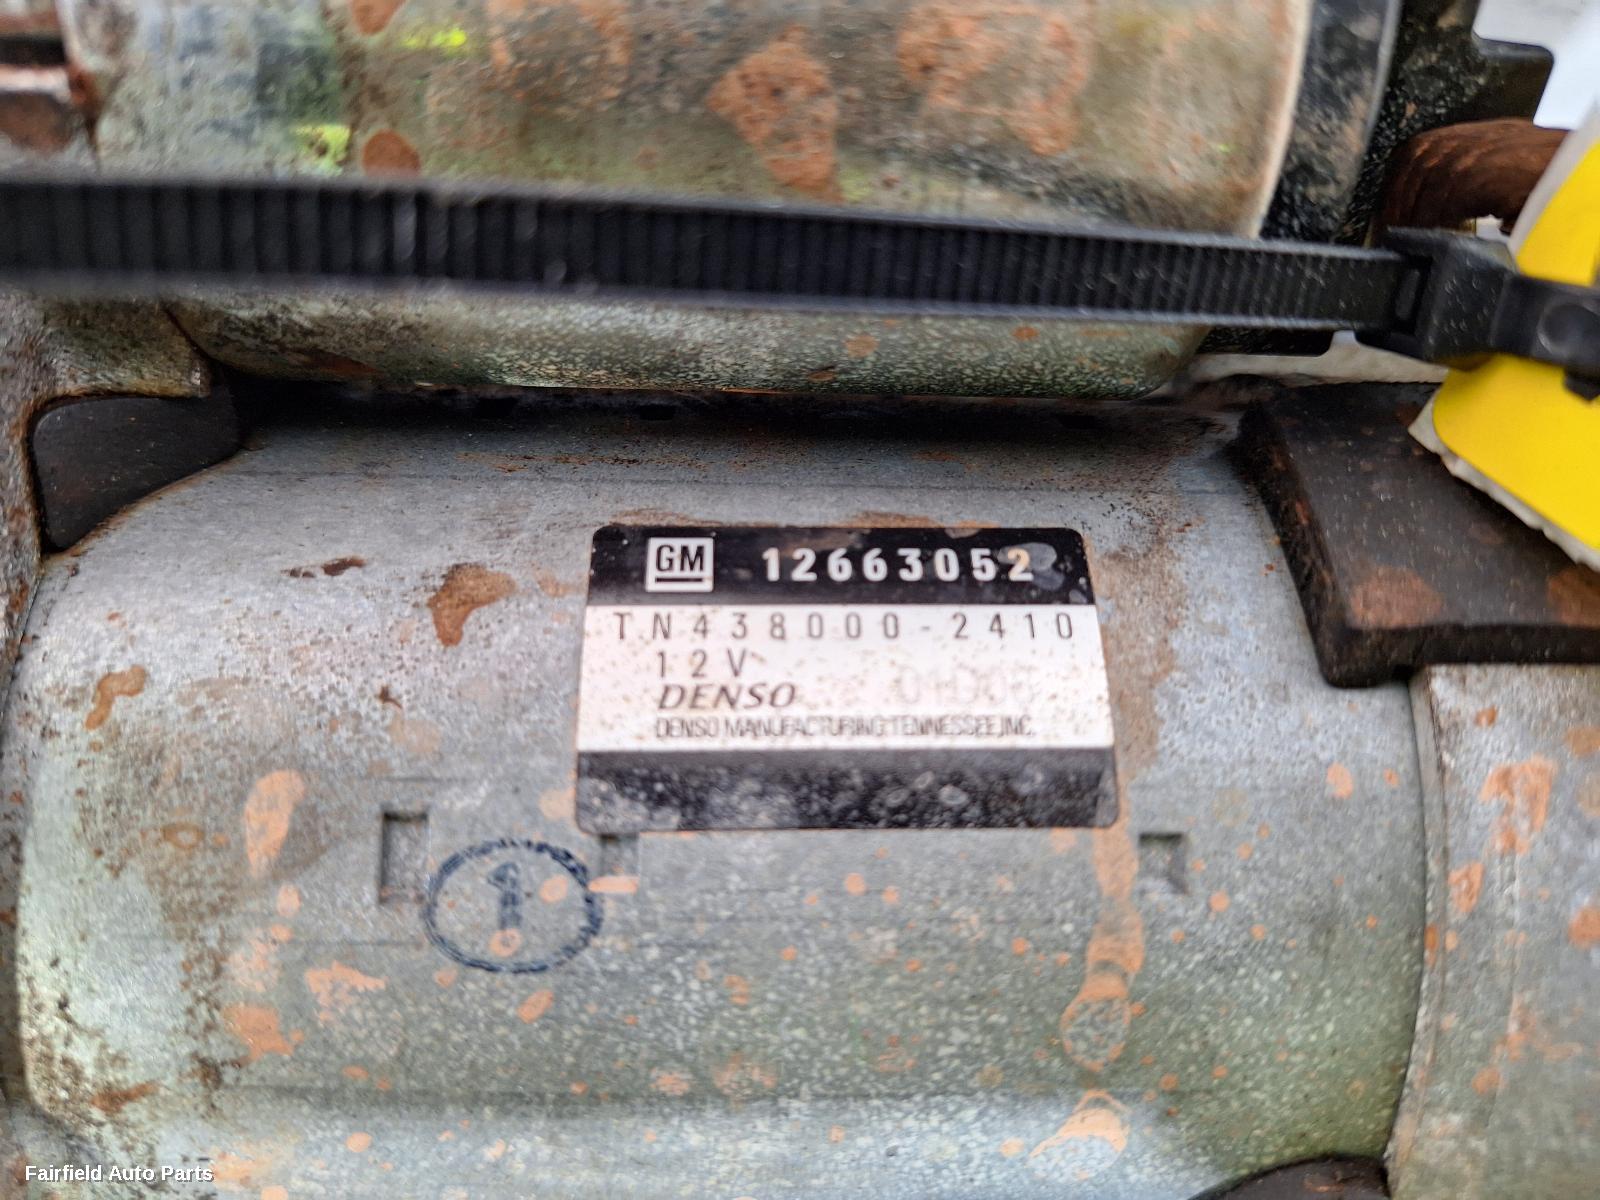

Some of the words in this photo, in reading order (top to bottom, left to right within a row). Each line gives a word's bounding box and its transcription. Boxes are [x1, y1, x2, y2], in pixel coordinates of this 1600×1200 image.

[656, 545, 706, 573] GM
[761, 547, 1034, 582] 12663052
[658, 682, 797, 710] DENSO
[655, 716, 719, 738] DENSO
[724, 716, 884, 738] MANUFACTURING
